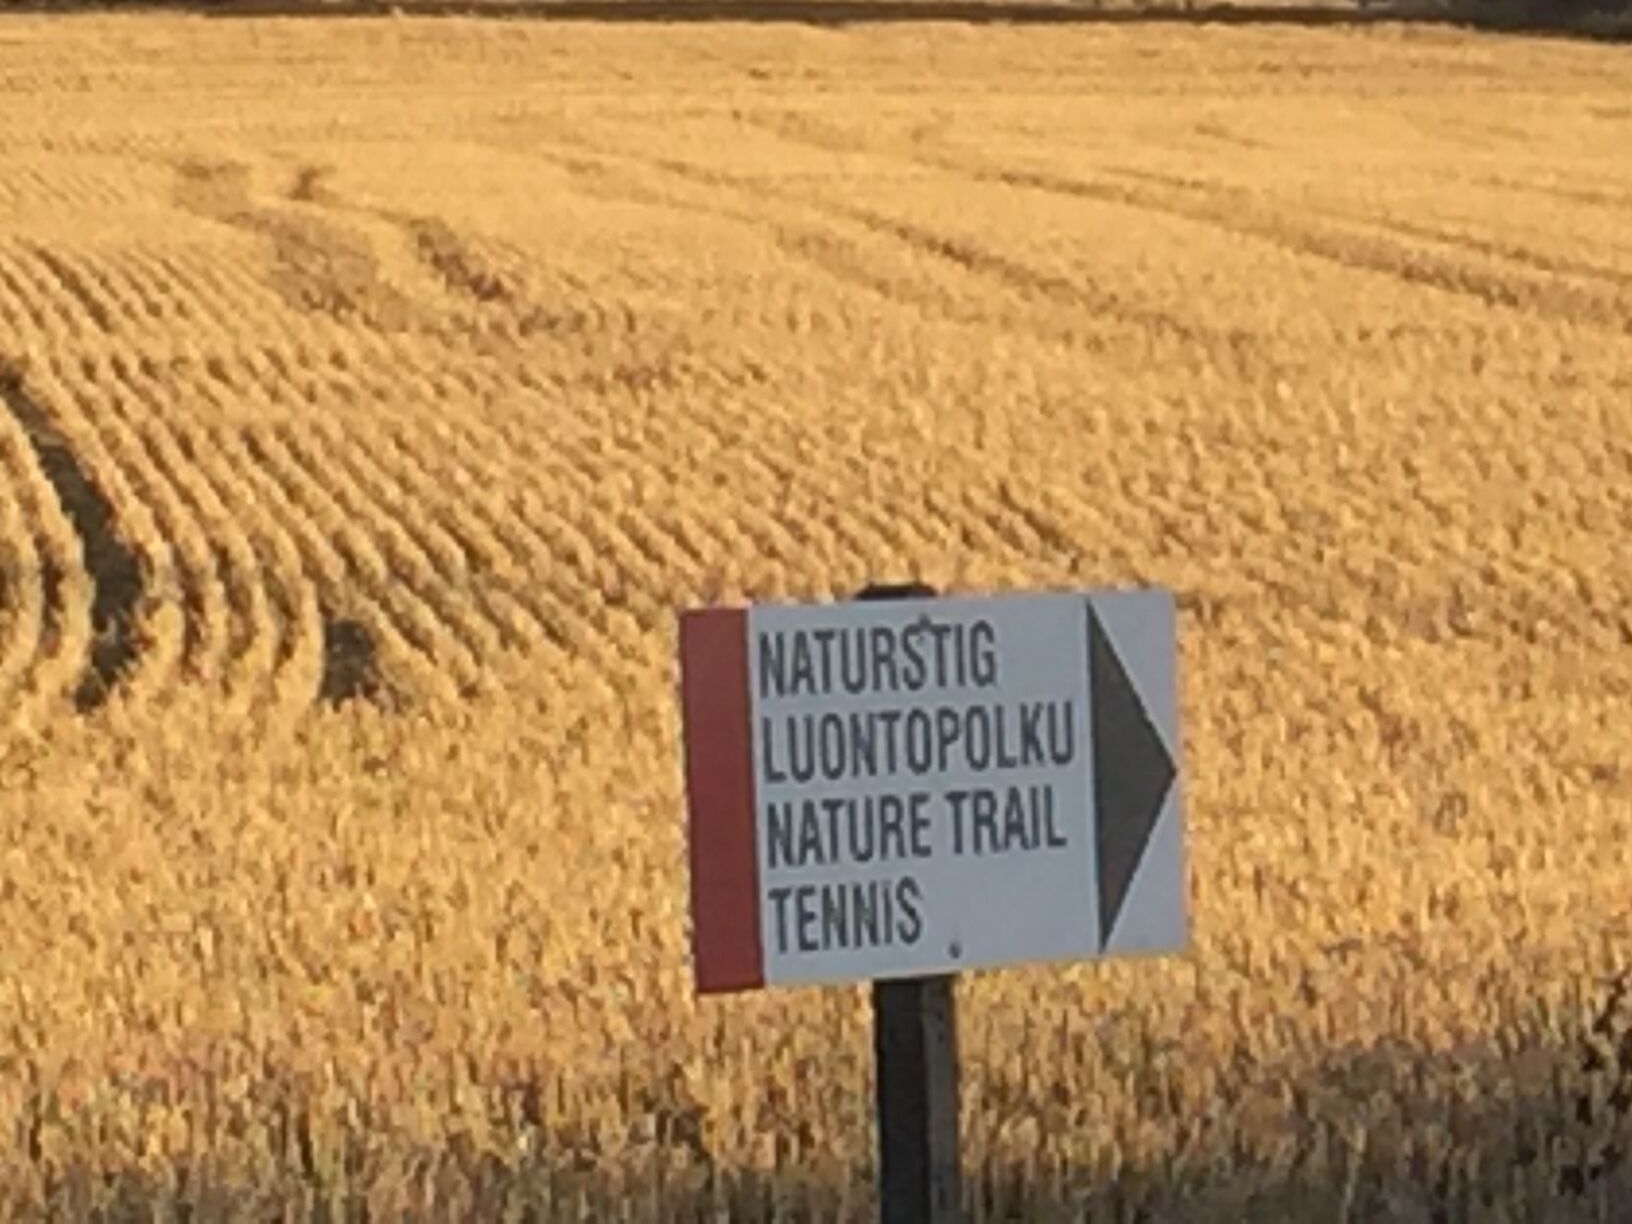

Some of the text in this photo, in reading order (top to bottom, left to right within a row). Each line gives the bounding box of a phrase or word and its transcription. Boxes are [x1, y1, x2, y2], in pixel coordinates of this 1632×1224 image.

[758, 620, 996, 698] NATURSTIG
[762, 701, 1075, 783] LUONTOPOLKU
[766, 785, 1067, 869] NATURE TRAIL
[768, 875, 923, 954] TENNIS
